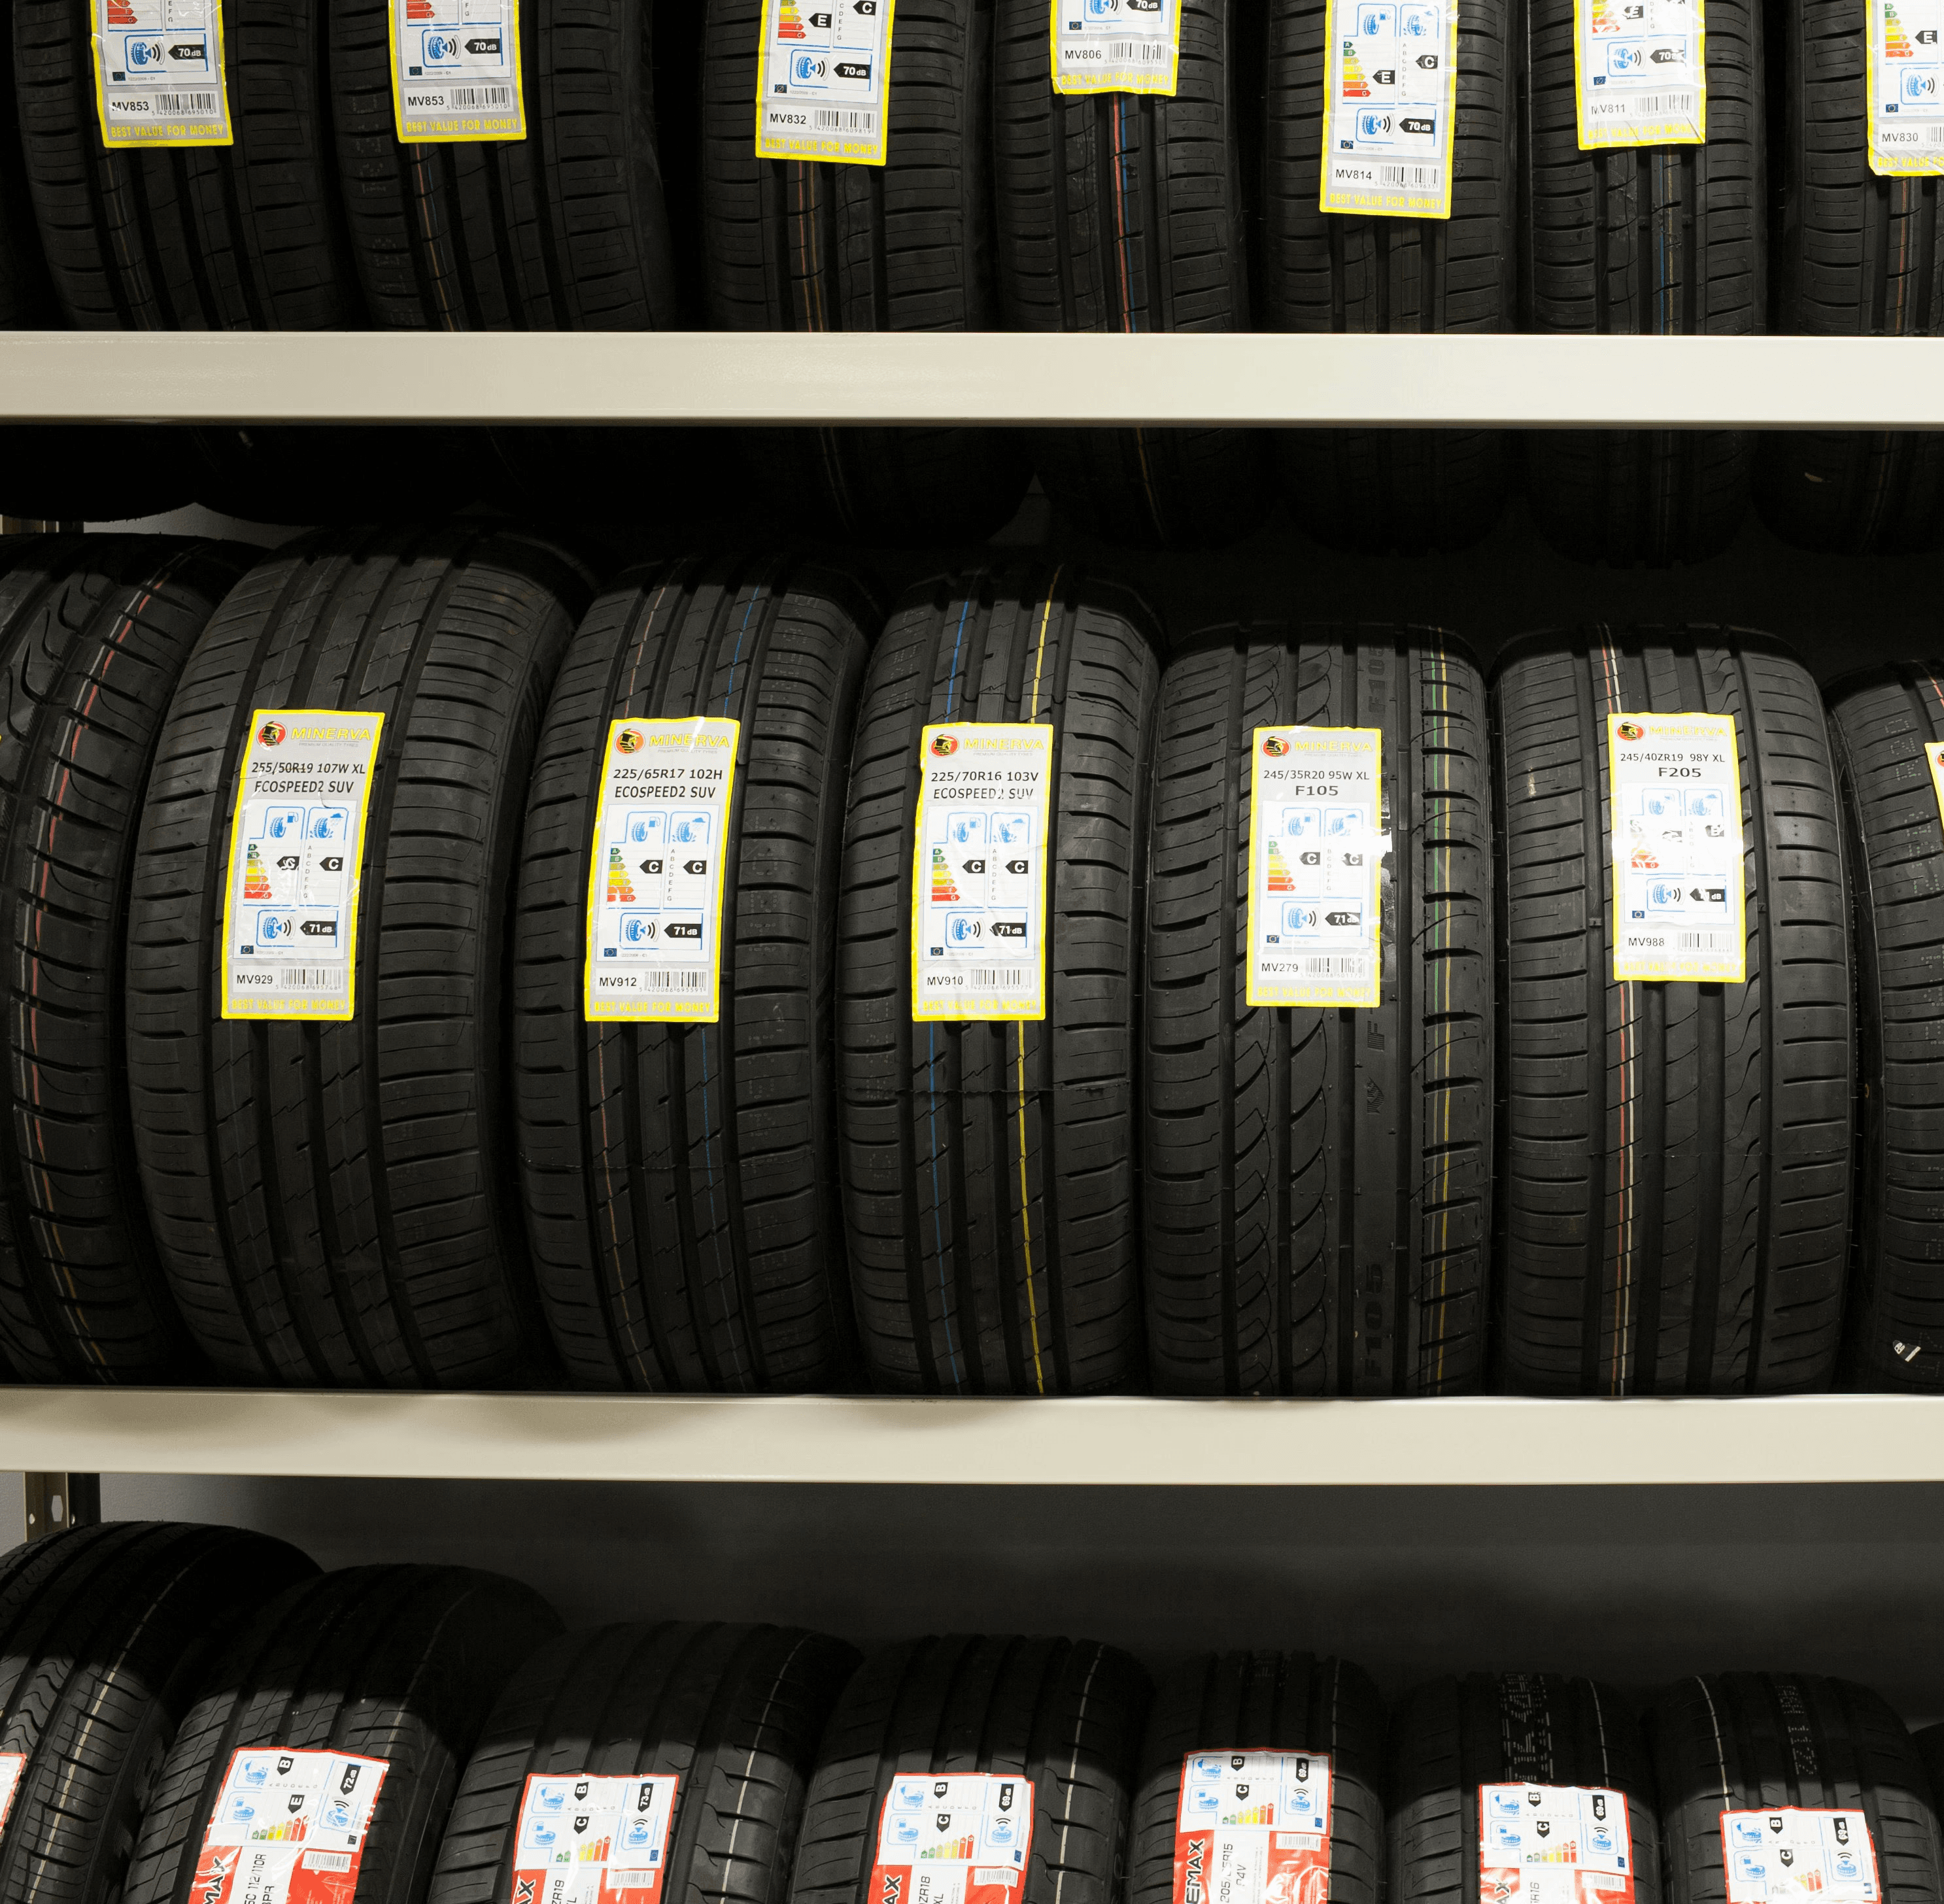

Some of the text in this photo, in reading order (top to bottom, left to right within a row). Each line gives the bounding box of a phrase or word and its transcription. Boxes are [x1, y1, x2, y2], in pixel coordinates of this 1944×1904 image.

[862, 3, 872, 13] C
[1136, 0, 1147, 8] 70
[817, 15, 827, 26] E
[1924, 32, 1933, 43] E
[1065, 50, 1101, 59] MV806
[1425, 57, 1435, 68] C
[844, 67, 855, 75] 70
[1061, 72, 1168, 85] BEST VALUE FOR MONEY
[1382, 71, 1391, 83] E
[112, 101, 149, 111] MV853
[408, 96, 444, 106] MV853
[1592, 104, 1625, 114] MV811
[770, 114, 806, 124] MV832
[111, 124, 224, 137] BEST VALUE FOR MONEY
[406, 119, 517, 132] BEST VALUE FOR MONEY
[1408, 122, 1420, 130] 70
[1882, 133, 1918, 142] MV830
[765, 138, 878, 155] BEST VALUE FOR MONEY
[1878, 157, 1929, 167] BEST VALUE
[1336, 169, 1372, 180] MV814
[1329, 194, 1441, 209] BEST VALUE FOR MONEY
[291, 728, 370, 740] MINERVA
[1649, 725, 1727, 736] MINERVA
[650, 734, 729, 747] MINERVA
[964, 738, 1044, 750] MINERVA
[1295, 741, 1373, 752] MINERVA
[1620, 753, 1683, 762] 245/40ZR19
[252, 762, 365, 775] 255/50R19 107W XL
[1659, 768, 1701, 777] F205
[613, 769, 723, 781] 225/65R17 102H
[931, 772, 1038, 782] 225/70R16 103V
[1264, 770, 1324, 780] 245/35R20
[1329, 770, 1352, 779] 95W
[254, 781, 354, 792] ECOSPEED2 SUV
[1295, 785, 1339, 796] F105
[615, 786, 715, 798] ECOSPEED2 SUV
[1009, 789, 1033, 799] SUV
[1307, 853, 1317, 864] C
[1349, 854, 1359, 864] C
[328, 858, 339, 870] C
[649, 861, 659, 872] C
[692, 862, 702, 873] C
[971, 861, 981, 872] C
[1014, 862, 1025, 873] C
[1335, 915, 1345, 923] 71
[309, 924, 320, 932] 71
[674, 926, 685, 935] 71
[1628, 938, 1665, 946] MV988
[1261, 963, 1298, 972] MV279
[237, 975, 273, 984] MV929
[600, 978, 637, 986] MV912
[927, 976, 963, 985] MV910
[1257, 986, 1278, 997] BEST
[1282, 987, 1310, 997] VALUE
[1314, 987, 1333, 997] FOR
[231, 999, 345, 1011] BEST VALUE FOR MONEY
[594, 1002, 710, 1012] BEST VALUE FOR MONEY
[923, 1000, 1036, 1011] BEST VALUE FOR MONEY
[280, 1759, 291, 1768] B
[344, 1777, 354, 1789] 72
[577, 1785, 587, 1794] B
[290, 1797, 302, 1806] E
[640, 1796, 649, 1806] 73
[1002, 1795, 1010, 1806] 69
[1595, 1806, 1605, 1816] 69
[576, 1818, 587, 1826] C
[1770, 1819, 1781, 1828] B
[1781, 1851, 1792, 1860] C
[248, 1854, 266, 1889] 112/110R
[919, 1877, 930, 1904] ZR18
